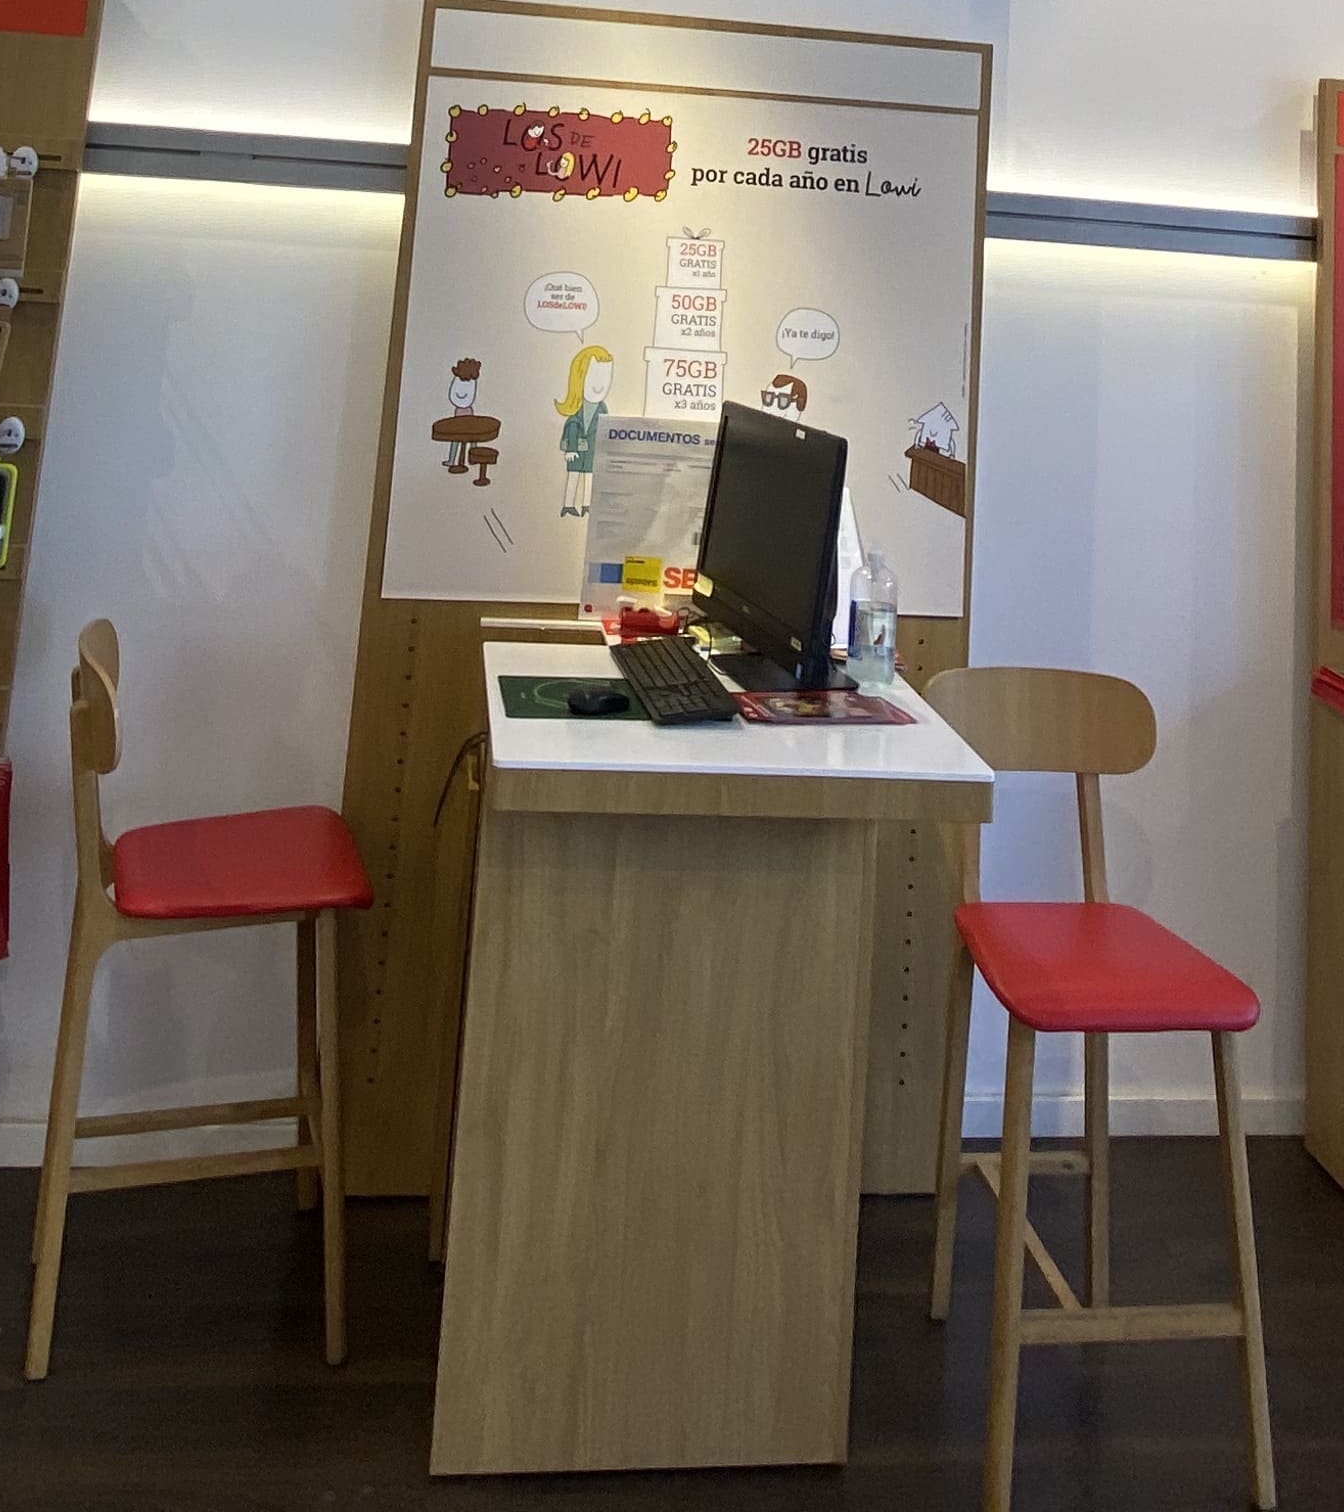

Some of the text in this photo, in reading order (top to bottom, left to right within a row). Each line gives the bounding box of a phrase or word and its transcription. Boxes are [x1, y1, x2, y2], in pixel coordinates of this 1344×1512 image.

[503, 118, 595, 152] LOS DE
[747, 137, 869, 168] 25GB gratis
[535, 151, 622, 189] LOWI
[691, 167, 922, 199] por cada año en Lowi
[680, 243, 717, 258] 25GB
[679, 258, 717, 270] GRATIS
[565, 293, 576, 301] de
[671, 294, 718, 312] 50GB
[671, 313, 717, 327] GRATIS
[681, 327, 716, 338] x2 años
[799, 329, 809, 338] te
[663, 358, 718, 379] 75GB
[662, 382, 717, 398] GRATIS
[674, 399, 716, 411] x3 años
[608, 428, 701, 445] DOCUMENTOS
